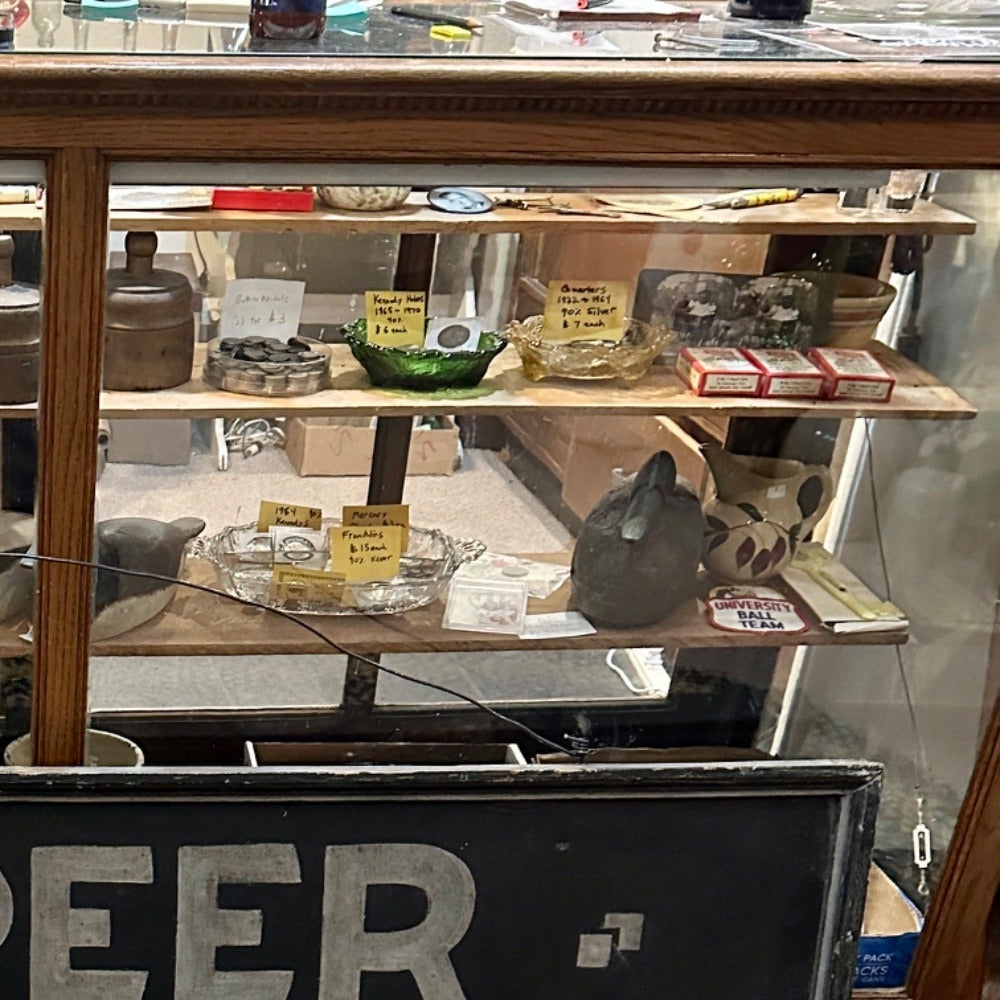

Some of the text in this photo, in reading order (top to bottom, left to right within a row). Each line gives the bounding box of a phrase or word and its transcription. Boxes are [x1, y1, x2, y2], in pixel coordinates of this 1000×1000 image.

[561, 284, 607, 294] Quarters
[275, 506, 297, 516] 1964
[714, 601, 793, 613] UNIVERSITY
[737, 610, 776, 621] BALL
[738, 620, 785, 630] TEAM
[863, 953, 895, 962] PACK
